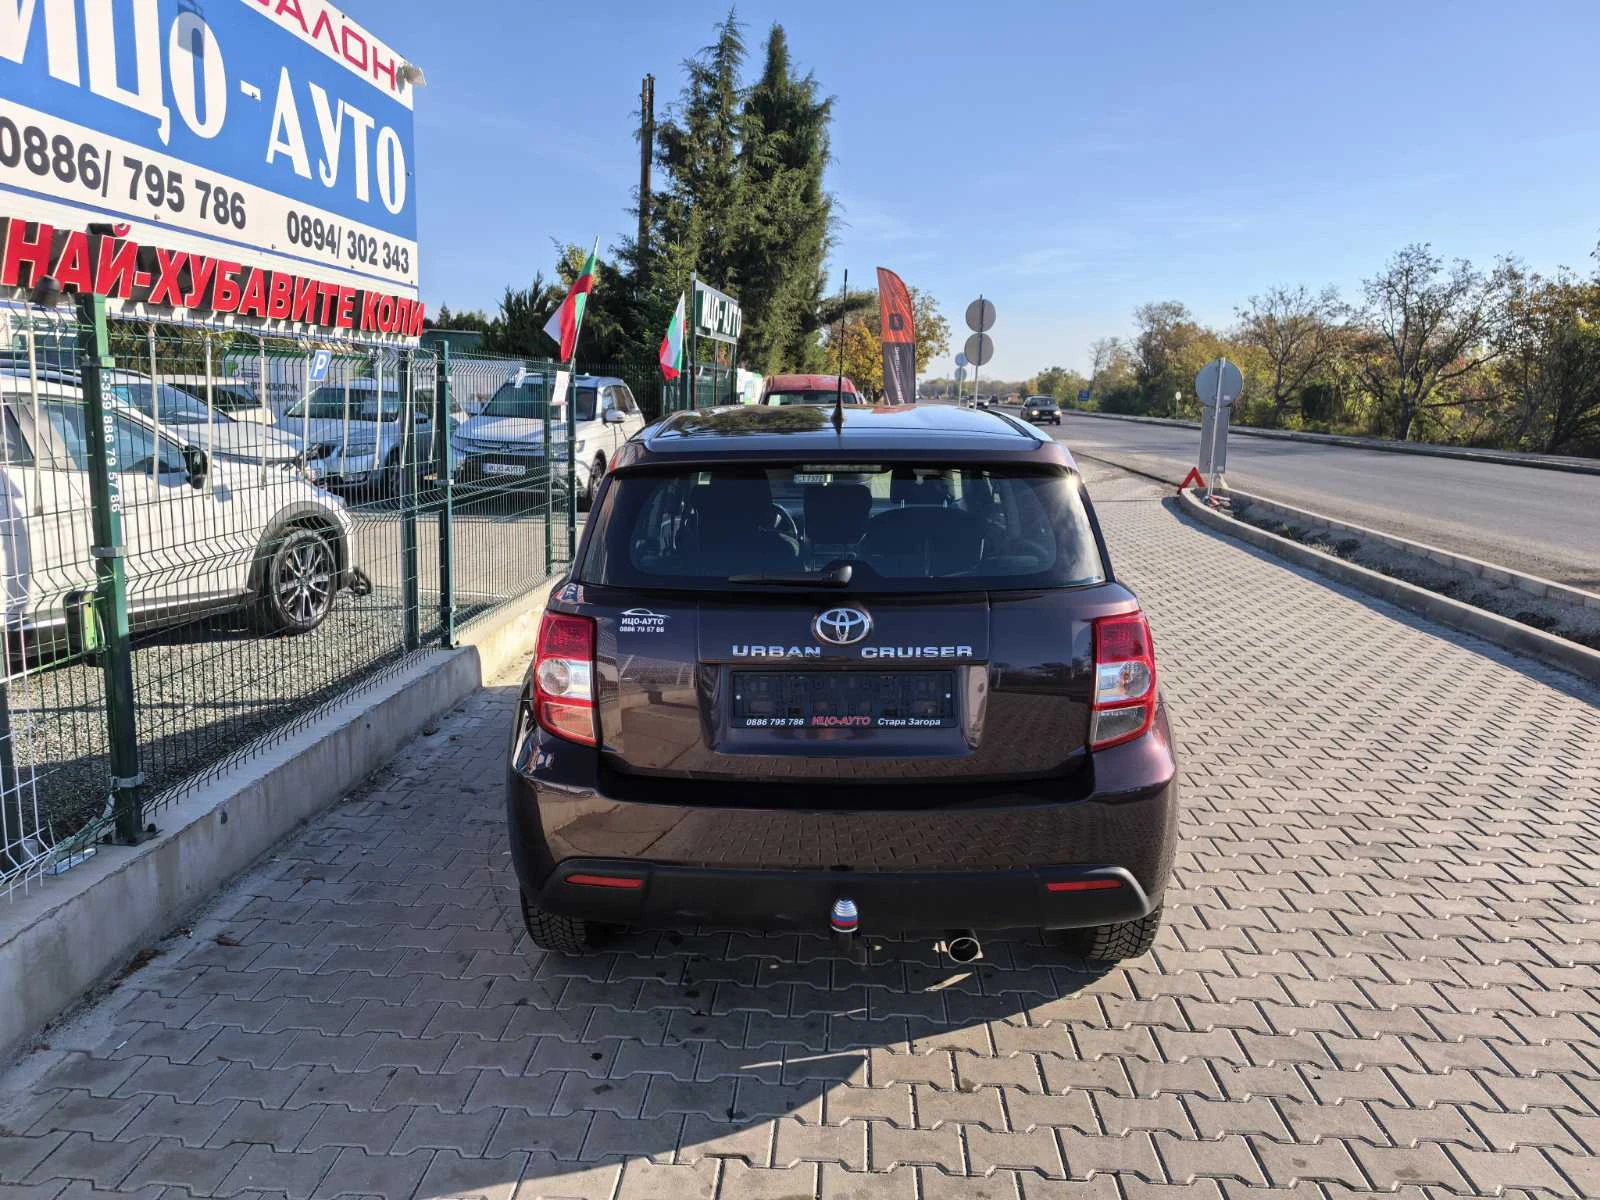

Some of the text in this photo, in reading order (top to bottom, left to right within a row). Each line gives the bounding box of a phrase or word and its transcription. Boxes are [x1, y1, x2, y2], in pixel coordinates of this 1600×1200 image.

[252, 0, 396, 91] АЛОН
[123, 156, 185, 212] 795
[195, 179, 246, 229] 786
[287, 210, 409, 274] 0894/ 302 343
[1, 218, 425, 337] НАЙ-ХУБАВИТЕ КОЛИ
[313, 354, 327, 378] P
[101, 371, 121, 513] +359 886 79 57 86
[621, 617, 664, 626] ИЦО-АУТО
[732, 645, 973, 658] URBAN CRUISER
[746, 716, 941, 727] 0886 795 786 ИЦО-АУТО Стара Загора
